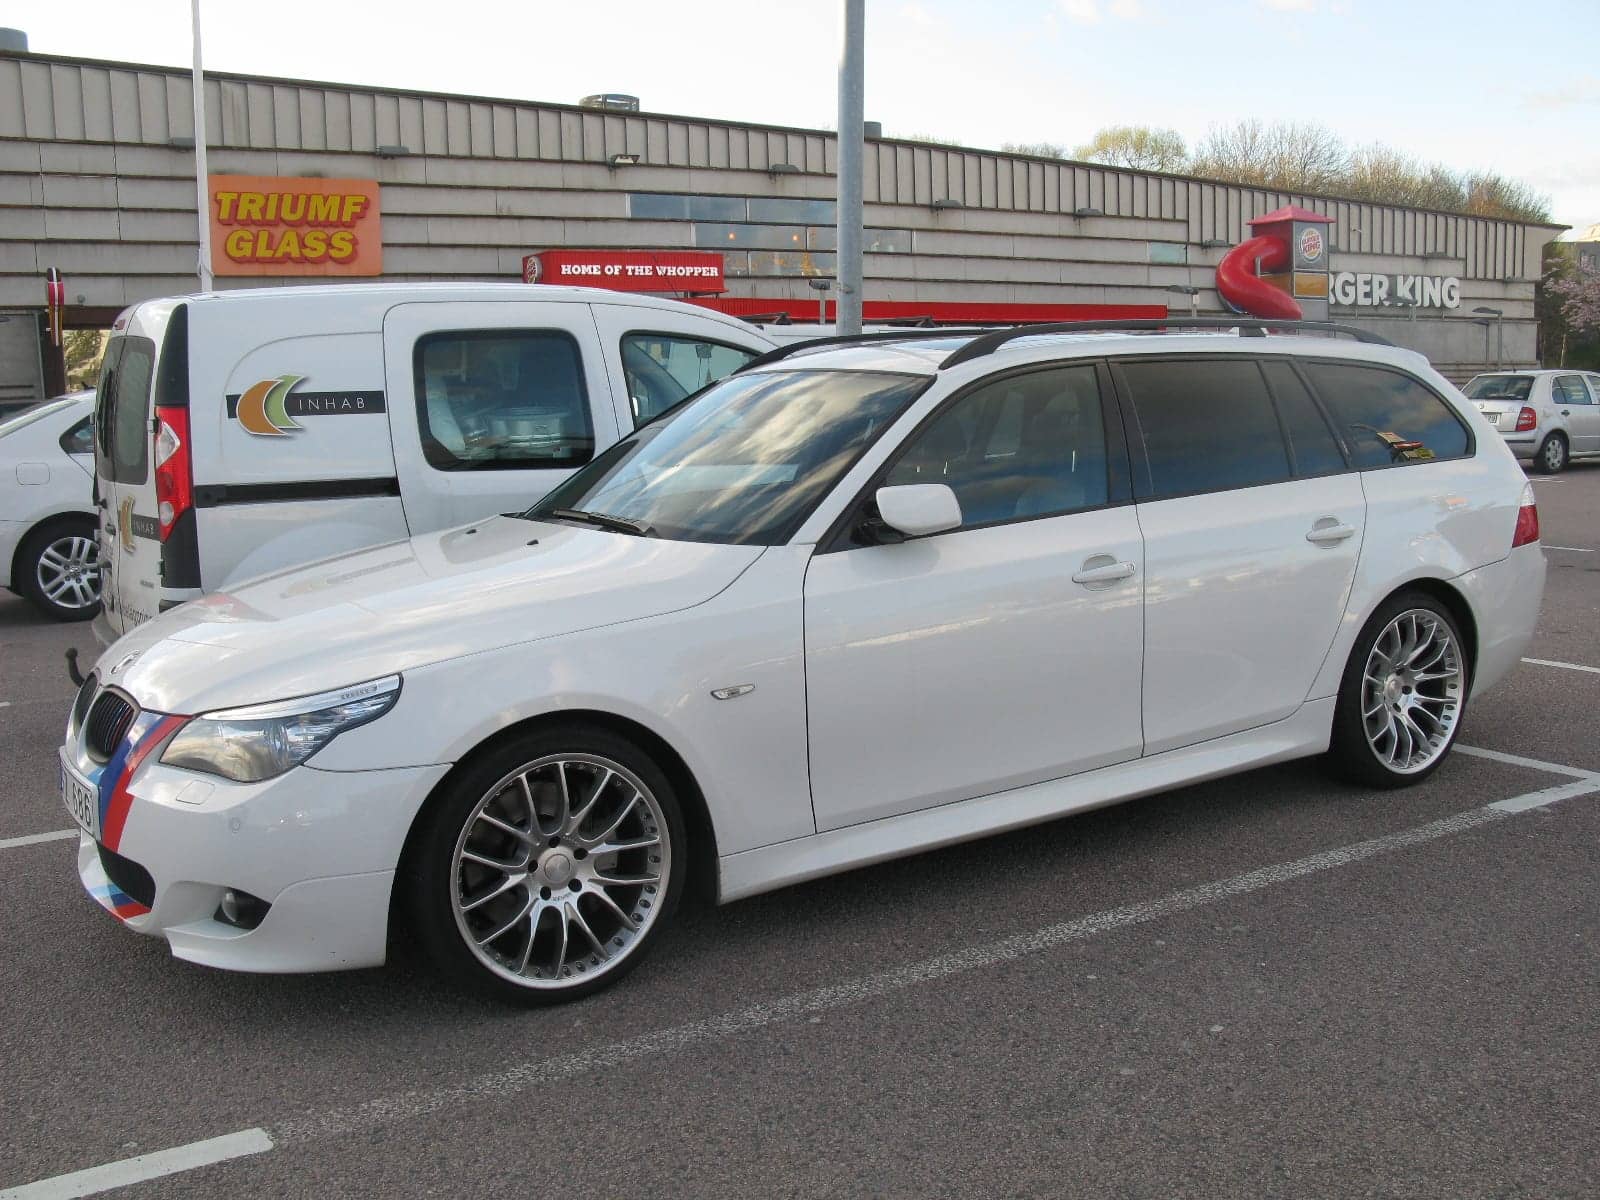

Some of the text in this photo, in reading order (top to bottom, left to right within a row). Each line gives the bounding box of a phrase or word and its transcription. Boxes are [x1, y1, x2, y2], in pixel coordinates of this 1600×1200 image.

[216, 191, 369, 226] TRIUMF
[225, 229, 357, 262] GLASS
[560, 264, 719, 277] HOME OF THE WHOPPER
[1396, 275, 1460, 309] KING
[299, 397, 366, 411] INHAB
